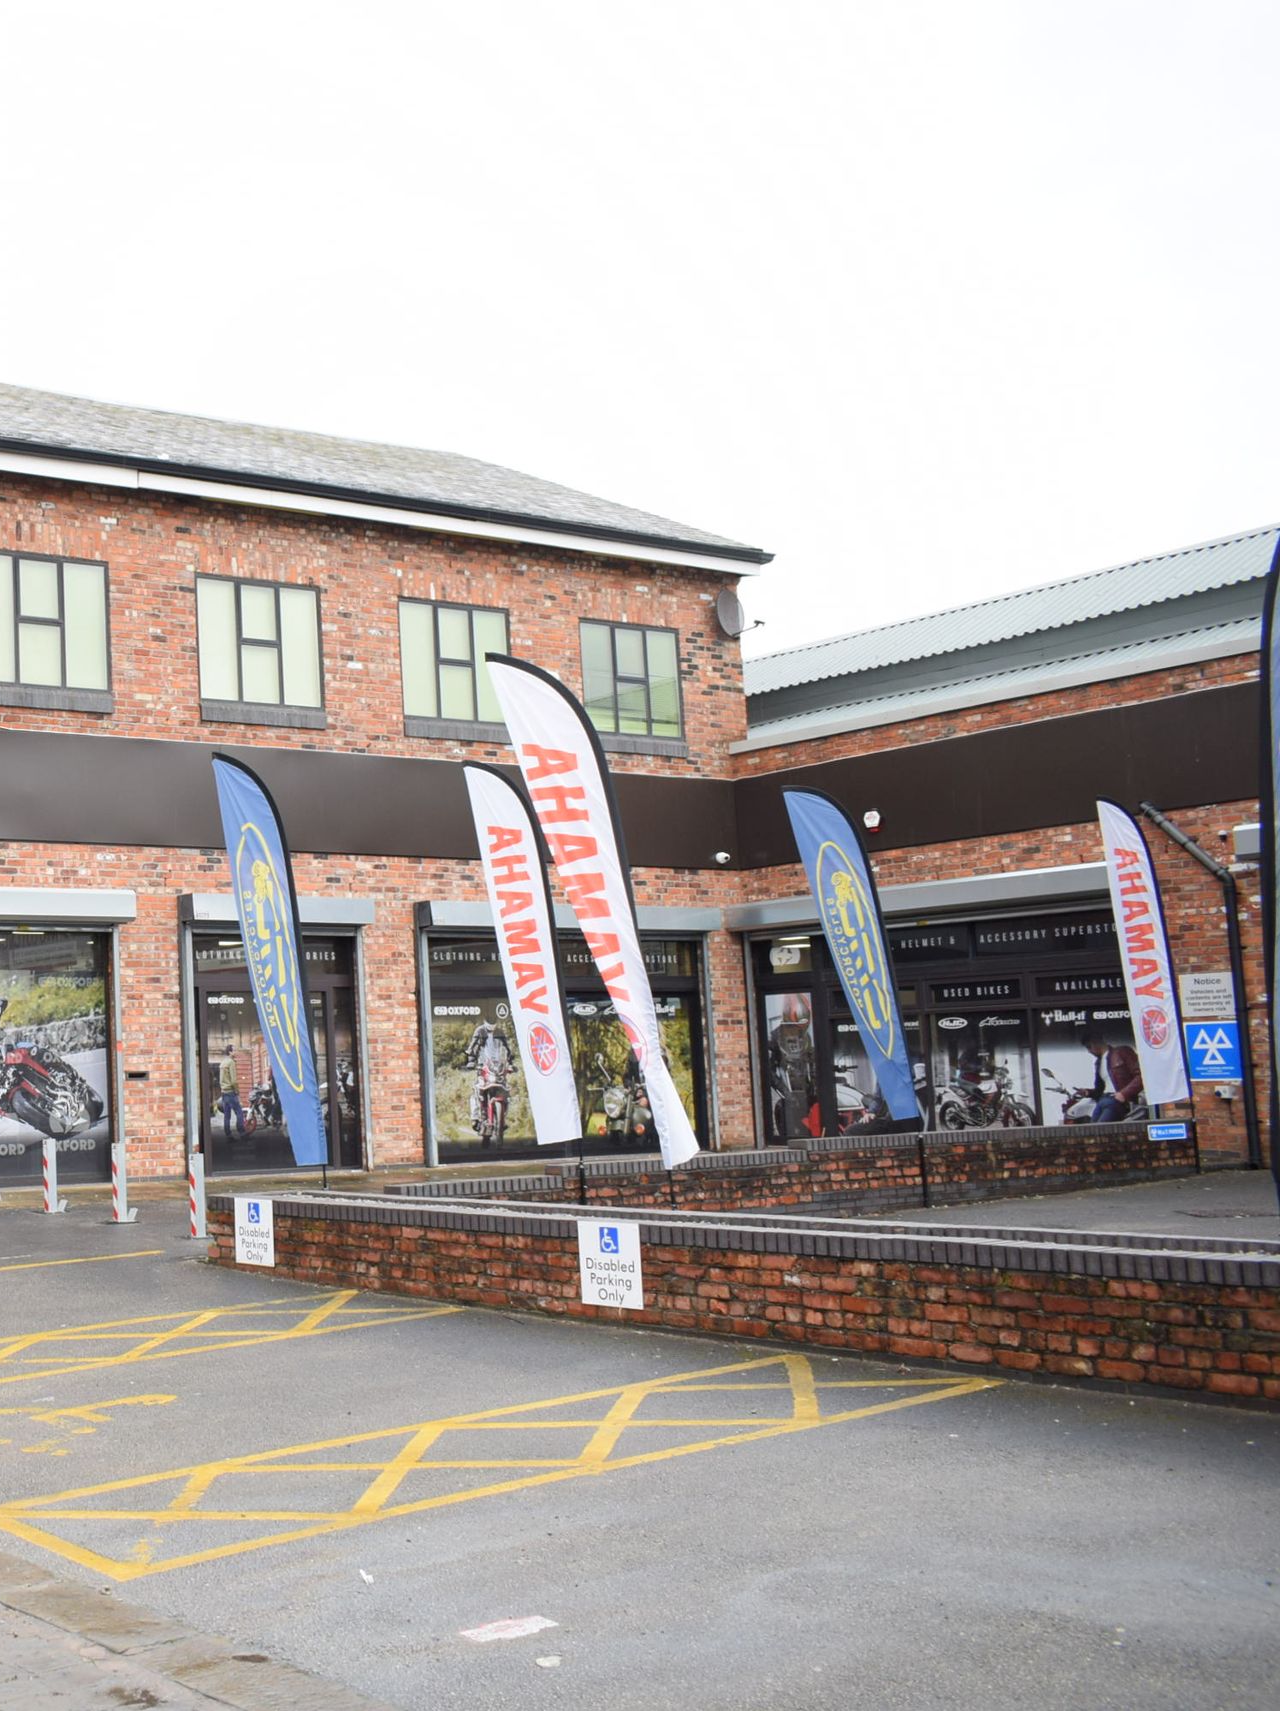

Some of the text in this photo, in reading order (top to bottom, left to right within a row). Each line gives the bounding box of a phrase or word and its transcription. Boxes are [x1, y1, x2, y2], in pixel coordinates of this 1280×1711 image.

[901, 936, 943, 949] HELMET
[979, 929, 1047, 944] ACCESSORY
[1055, 923, 1117, 937] SUPERSTO
[567, 954, 595, 963] ACCES
[1055, 978, 1122, 991] AVAILABLE
[943, 985, 1010, 998] USED BIKES
[448, 1006, 481, 1015] OXFORD
[1107, 1010, 1130, 1019] OXFO
[239, 1226, 270, 1239] Disabled
[241, 1239, 268, 1252] Parking
[246, 1250, 263, 1263] Only
[585, 1257, 635, 1273] Disabled
[590, 1272, 632, 1291] Parking
[598, 1288, 625, 1305] Only
